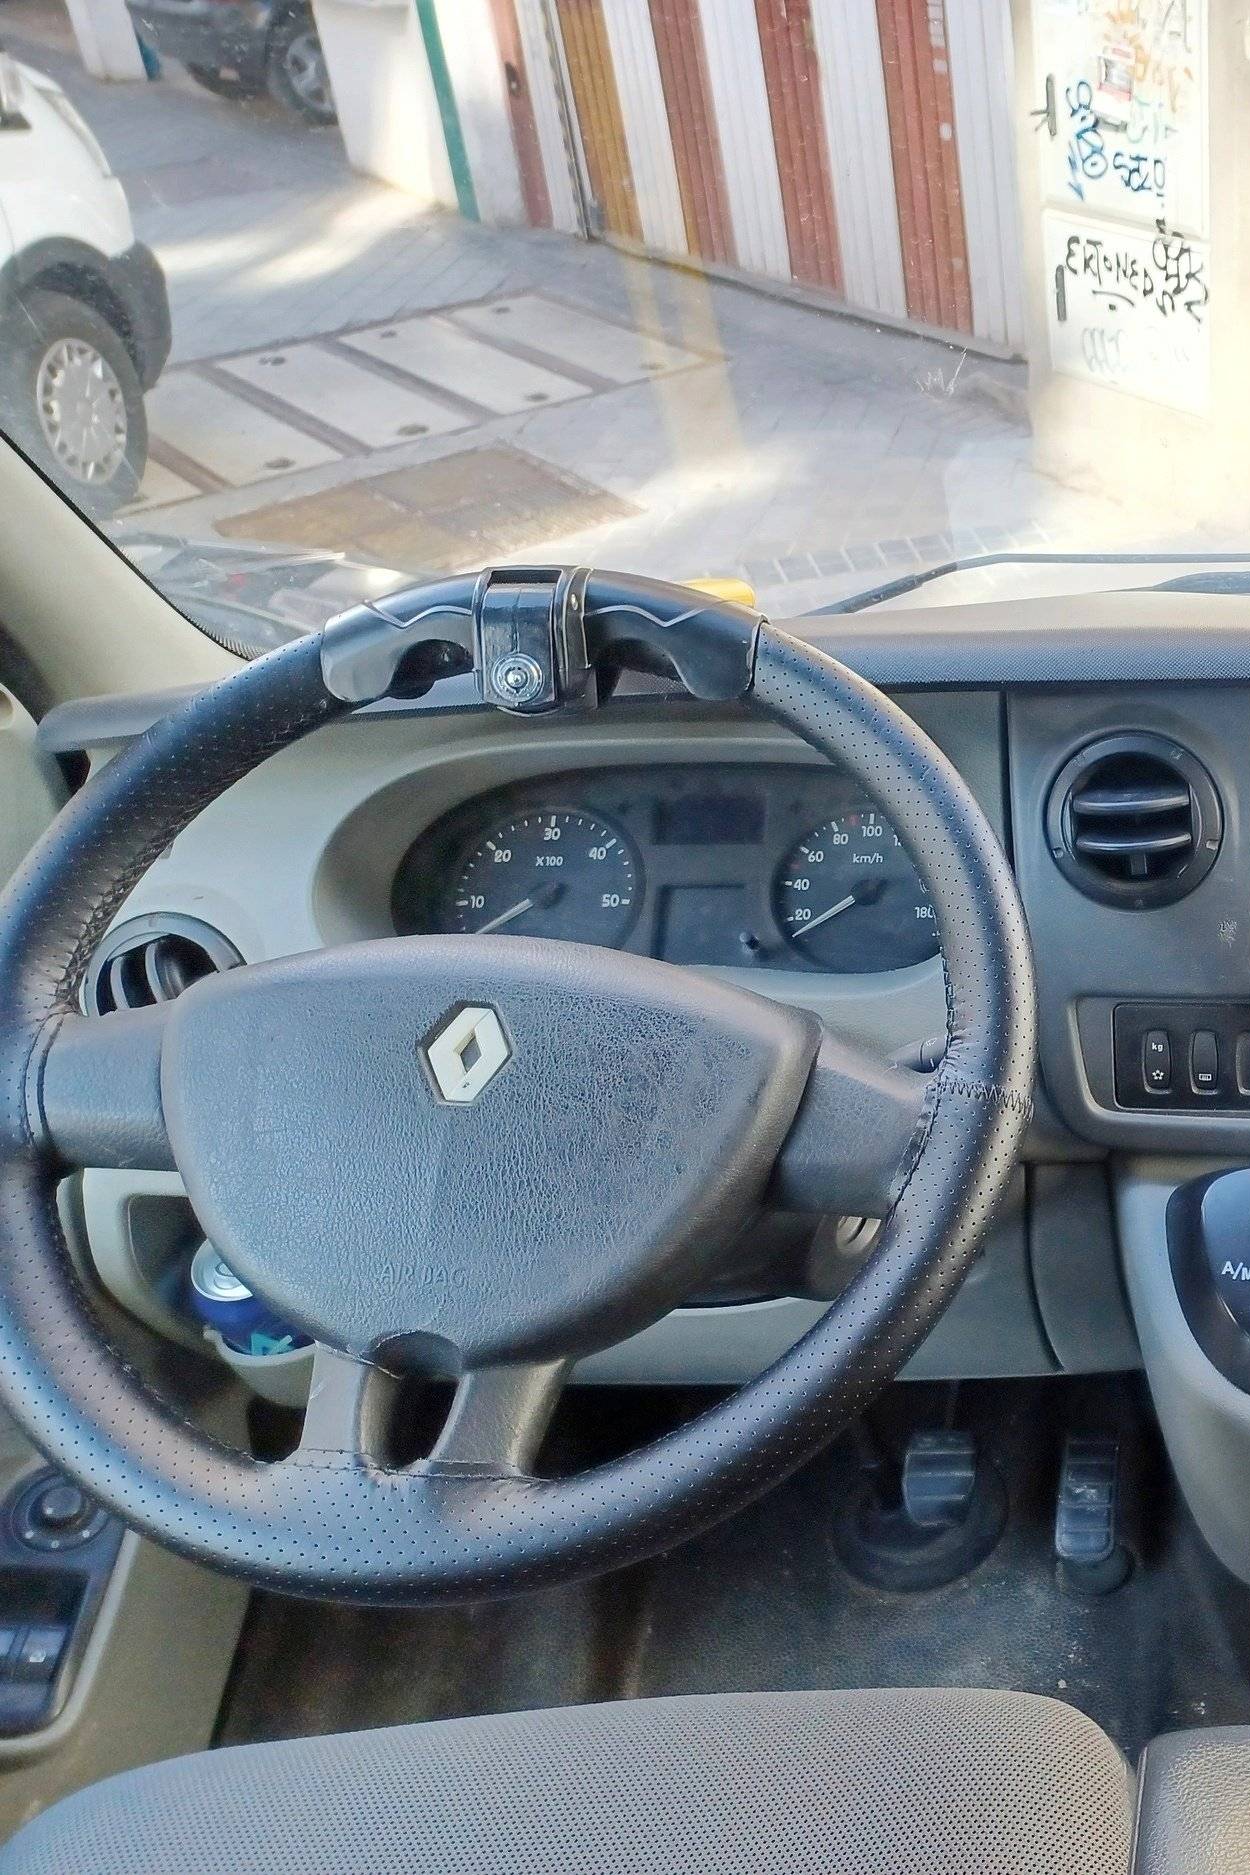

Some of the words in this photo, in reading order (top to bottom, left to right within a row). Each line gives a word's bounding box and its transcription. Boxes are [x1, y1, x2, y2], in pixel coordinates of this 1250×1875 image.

[543, 827, 561, 841] 30
[861, 825, 883, 837] 100
[832, 833, 849, 845] 80
[494, 849, 512, 863] 20
[588, 846, 607, 860] 40
[807, 850, 824, 863] 60
[852, 852, 884, 864] km/h
[793, 878, 810, 891] 40
[470, 895, 485, 909] 10
[600, 893, 620, 908] 50
[794, 908, 811, 921] 20
[1151, 1042, 1164, 1052] kg
